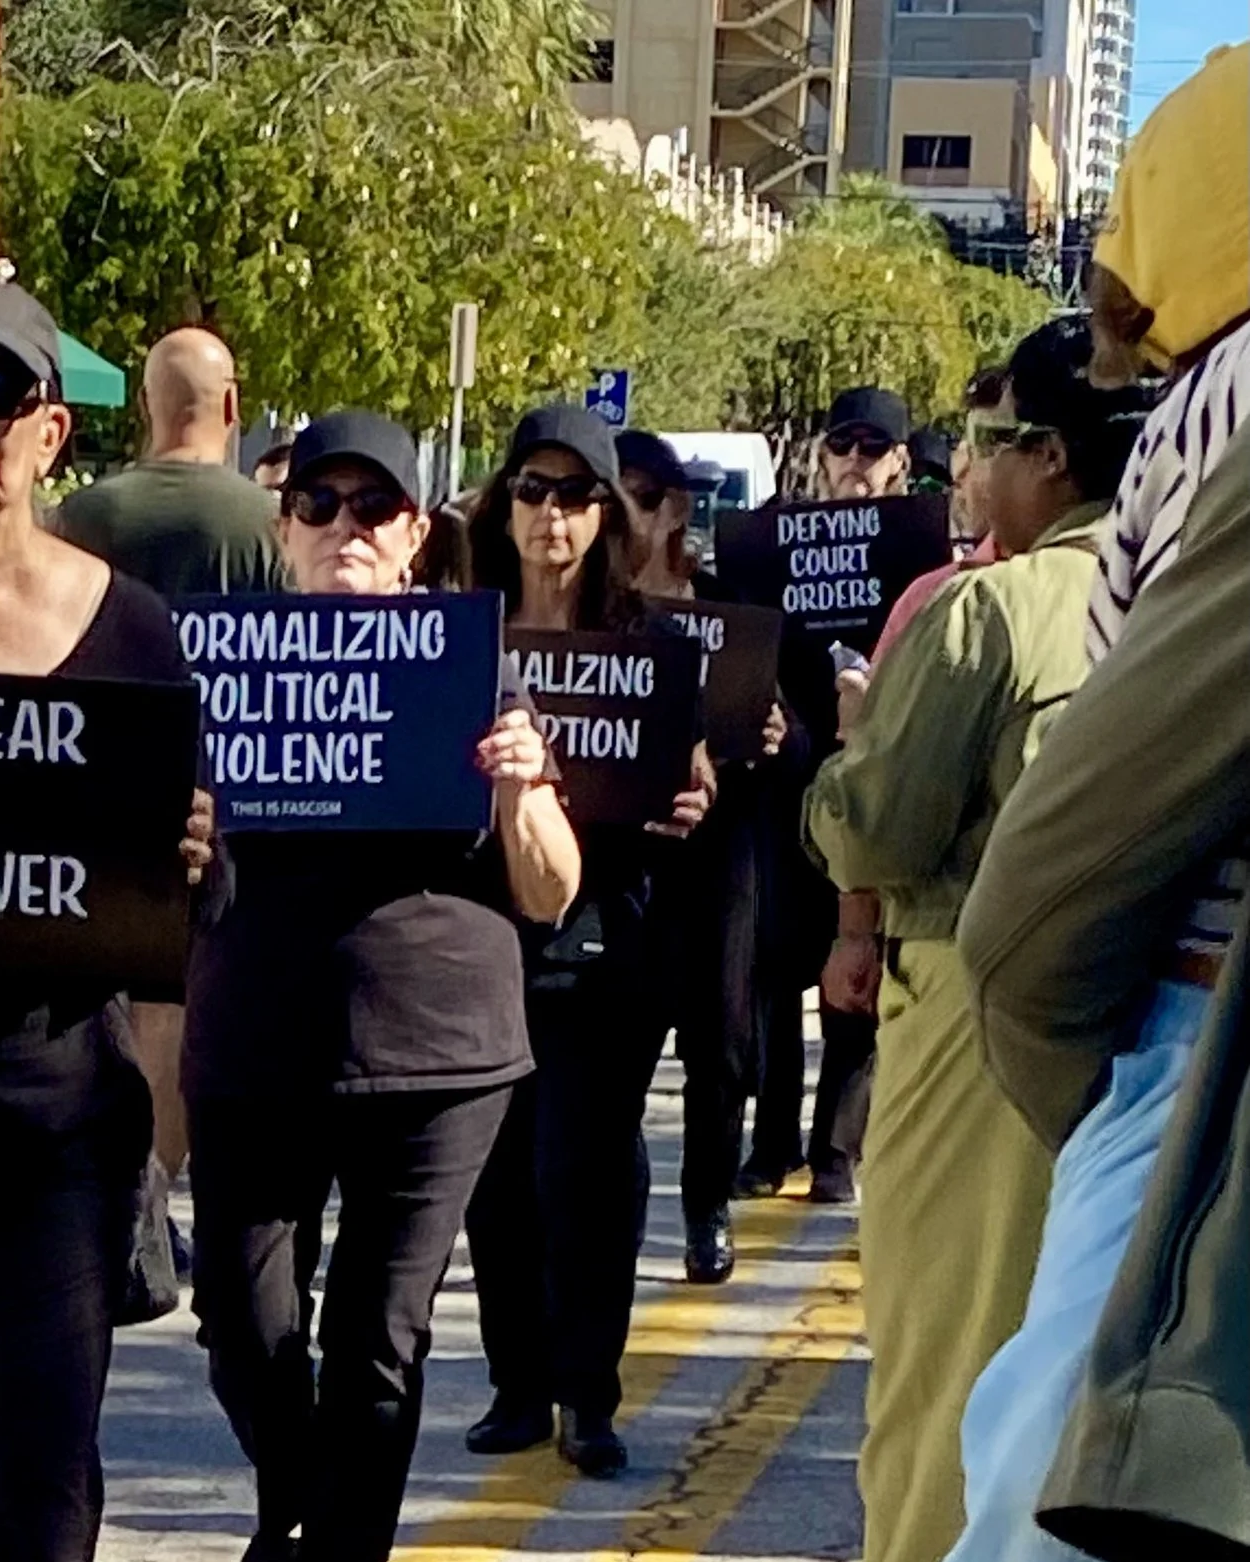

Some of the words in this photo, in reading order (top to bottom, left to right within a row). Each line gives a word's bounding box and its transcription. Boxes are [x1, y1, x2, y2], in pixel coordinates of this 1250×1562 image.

[600, 373, 616, 397] P
[778, 507, 880, 547] DEFYING
[791, 544, 868, 577] COURT
[783, 578, 881, 612] ORDERS
[172, 610, 444, 661] ORMALIZING
[508, 649, 655, 698] ALIZING
[231, 801, 263, 816] THIS
[266, 801, 280, 817] IS
[281, 801, 341, 816] FASCISM
